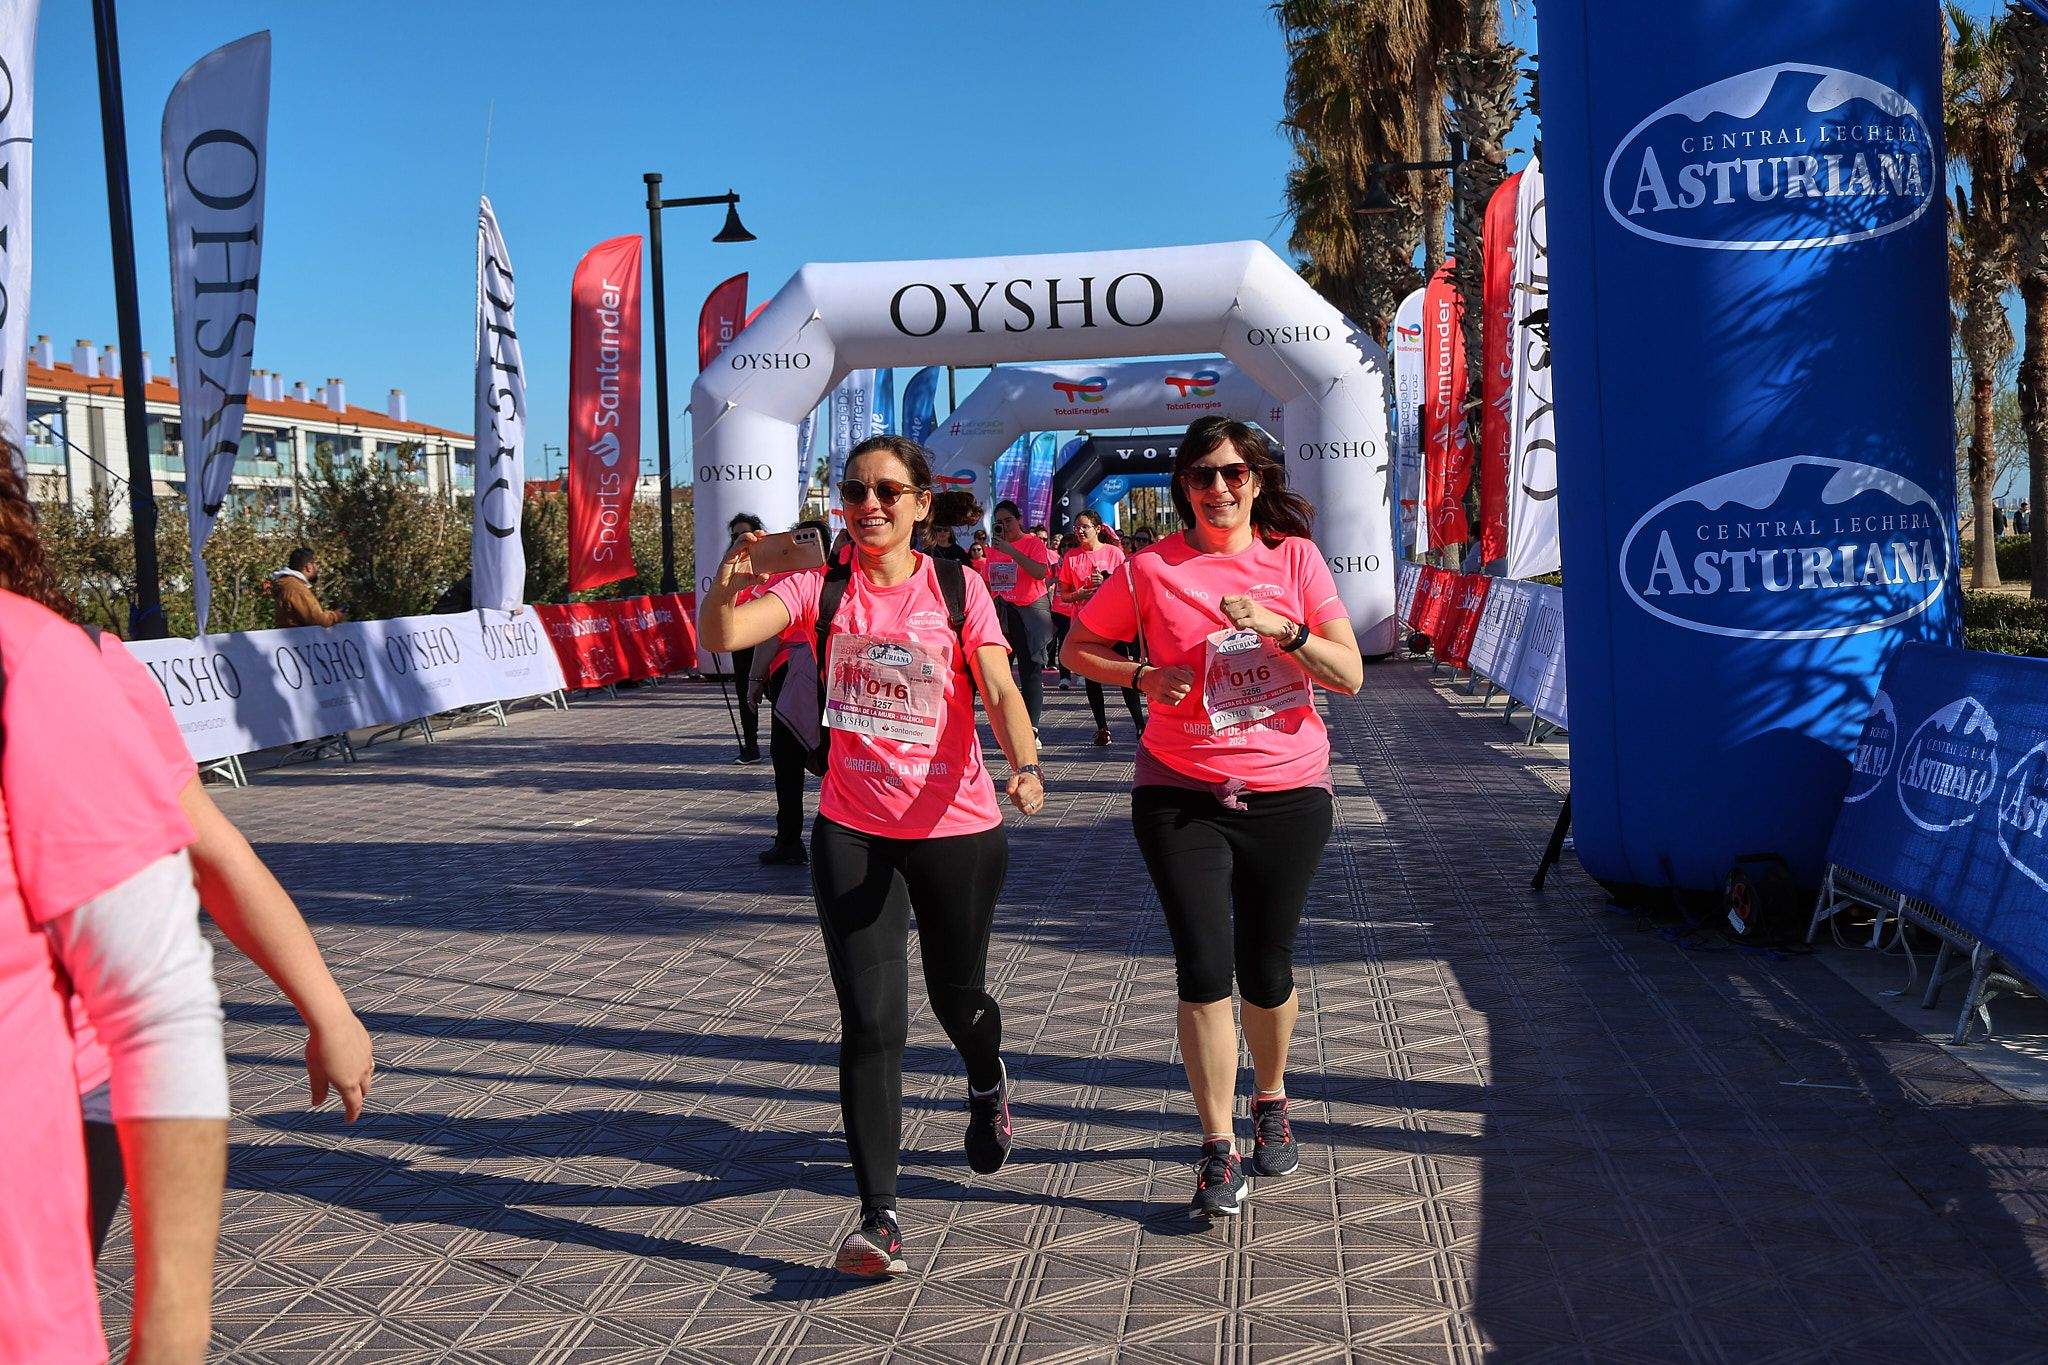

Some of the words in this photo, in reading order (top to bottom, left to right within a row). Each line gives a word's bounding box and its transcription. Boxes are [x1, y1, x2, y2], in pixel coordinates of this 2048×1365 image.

[1682, 128, 1806, 154] CENTRAL
[1820, 125, 1917, 143] LECHERA
[1627, 146, 1925, 216] ASTURIANA
[890, 272, 1164, 337] OYSHO
[1247, 325, 1331, 346] OYSHO
[594, 277, 622, 427] Santander
[731, 353, 811, 371] OYSHO
[1435, 298, 1453, 419] Santander
[1054, 407, 1110, 416] TotalEnergies
[1166, 400, 1223, 411] TotalEnergies
[1299, 440, 1377, 461] OYSHO
[699, 464, 773, 482] OYSHO
[592, 472, 621, 563] Sports
[1697, 520, 1820, 541] CENTRAL
[1835, 514, 1931, 534] LECHERA
[1643, 530, 1939, 596] ASTURIANA
[385, 626, 460, 675] OYSHO
[482, 621, 538, 661] OYSHO
[276, 639, 365, 690] OYSHO
[1229, 665, 1271, 687] 016
[866, 679, 908, 699] 016
[872, 700, 893, 710] 3257
[879, 710, 896, 719] MUJER
[1214, 709, 1247, 723] OYSHO
[835, 714, 870, 728] OYSHO
[890, 725, 924, 737] Santander
[844, 756, 882, 774] CARRERA
